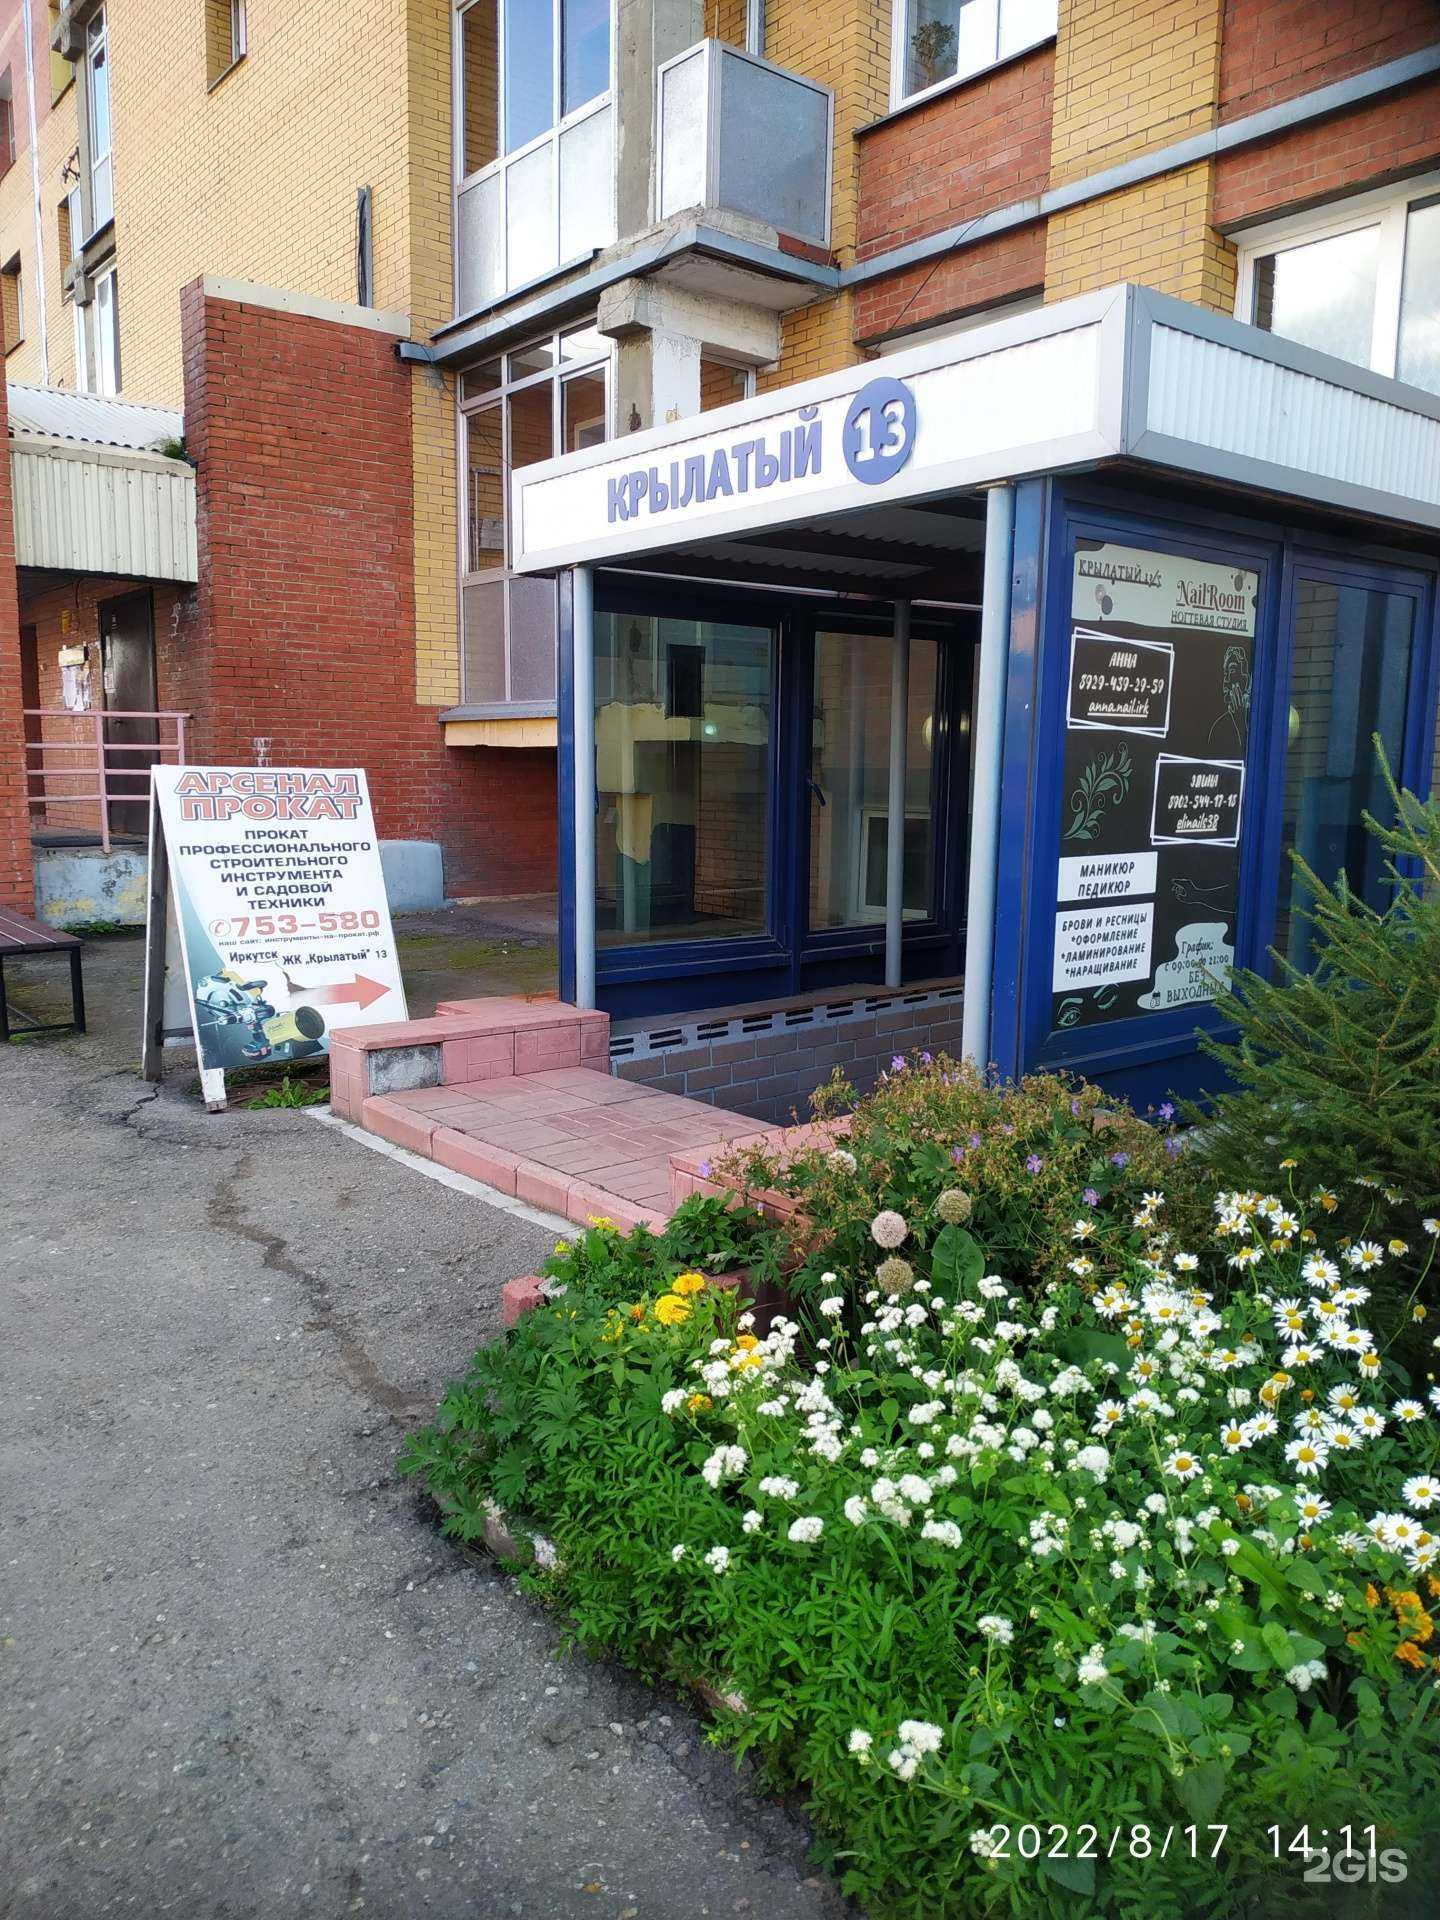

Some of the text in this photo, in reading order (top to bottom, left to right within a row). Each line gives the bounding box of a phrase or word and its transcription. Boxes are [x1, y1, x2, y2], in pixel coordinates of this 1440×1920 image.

[607, 399, 906, 523] КРЫЛАТЫЙ 13
[1078, 559, 1142, 582] КРЫЛАТЫЙ
[1171, 610, 1248, 631] НОГТЕВАЯ СТУДИЯ
[1109, 652, 1138, 668] АННА
[1079, 673, 1165, 694] 8929-439-29-59
[175, 772, 360, 796] АРСЕНАЛ
[180, 795, 364, 822] ПРОКАТ
[1176, 813, 1219, 830] elinails38
[244, 829, 309, 841] ПРОКАТ
[179, 841, 371, 856] ПРОФЕССИОНАЛЬНОГО
[210, 854, 348, 870] СТРОИТЕЛЬНОГО
[1080, 861, 1135, 878] МАНИКЮР
[220, 869, 343, 883] ИНСТРУМЕНТА
[236, 882, 333, 897] И САДОВОЙ
[1078, 880, 1131, 899] ПЕДИКЮР
[248, 897, 326, 911] ТЕХНИКИ
[231, 910, 380, 937] 753-580
[1062, 912, 1147, 932] БРОВИ И РЕСНИЦЫ
[229, 950, 279, 965] Иркутск
[282, 954, 301, 966] ЖК
[375, 949, 388, 959] 13
